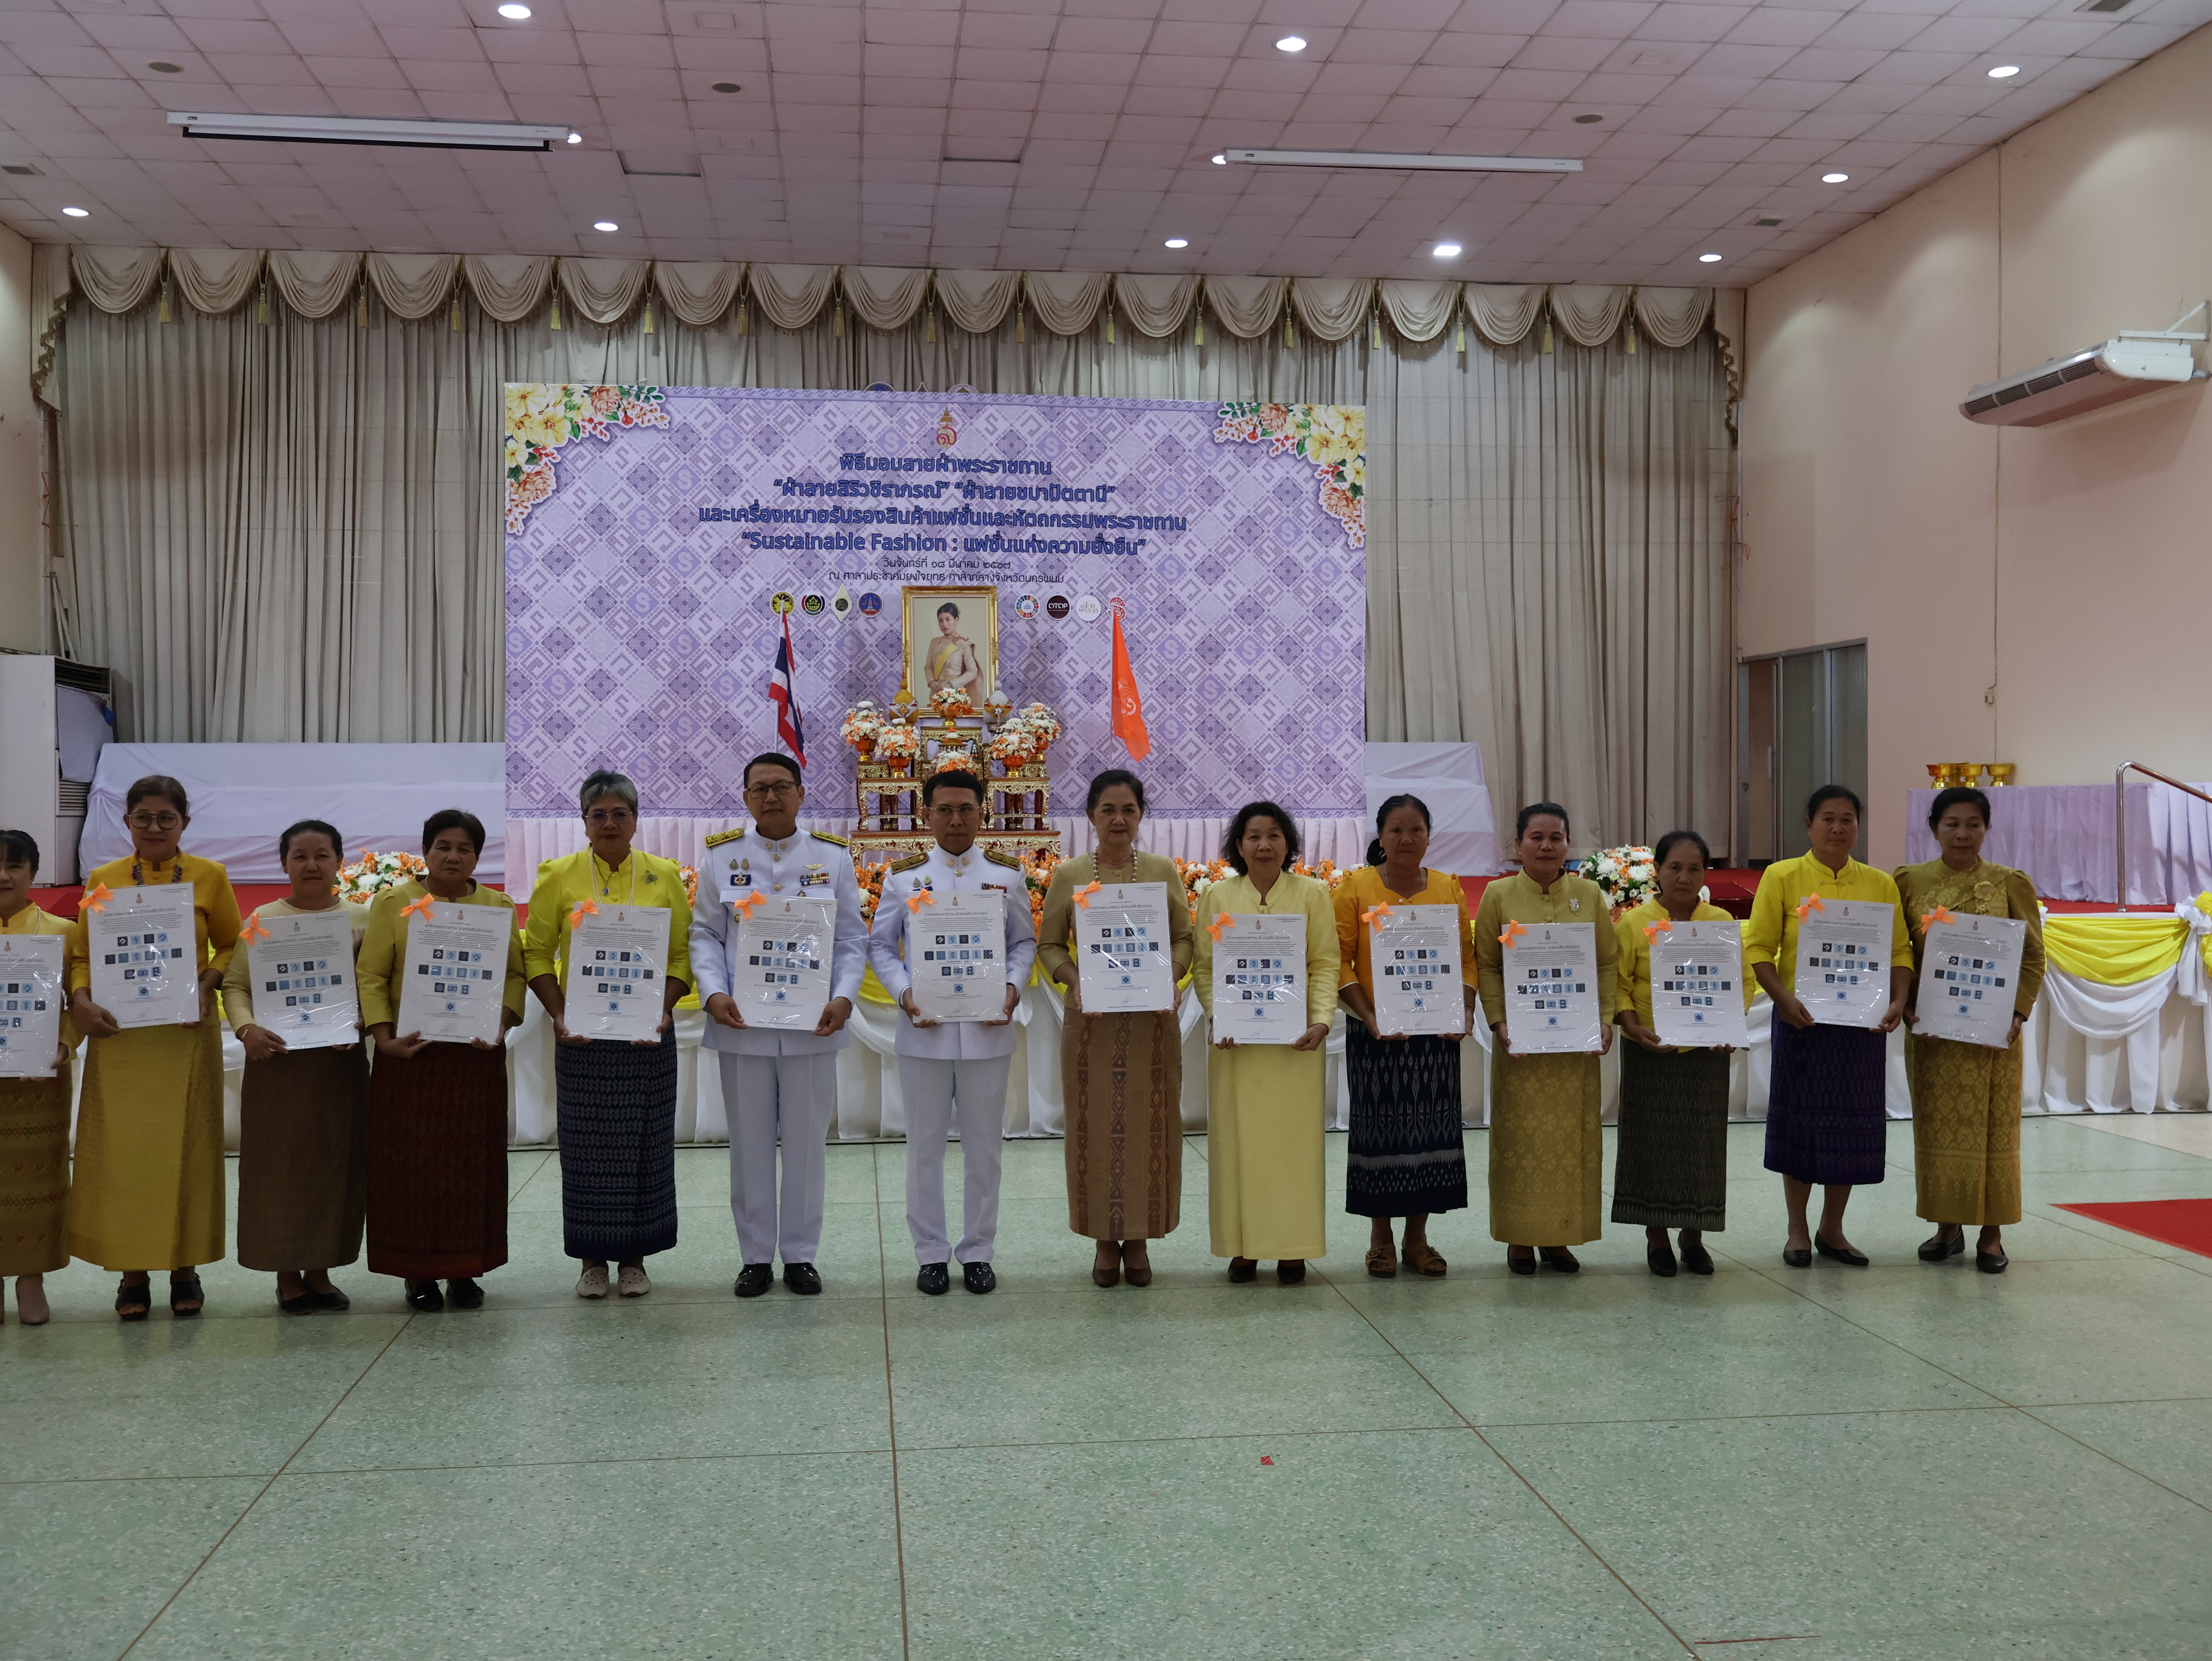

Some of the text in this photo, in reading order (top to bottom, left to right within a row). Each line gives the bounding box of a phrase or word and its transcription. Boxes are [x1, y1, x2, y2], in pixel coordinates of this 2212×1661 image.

[839, 453, 1052, 475] พิธีมอบลายผ้าพระราชทาน
[773, 477, 1116, 502] “ผ้าลายสิริวชิราภรณ์” “ผ้าลายชบาปัตตานี”
[699, 500, 1187, 530] และเครื่องหมายรับรองสินค้าแฟชั่นและหัตถกรรมพระราชทาน
[741, 531, 1146, 555] “Sustainable Fashion : แฟชั่นแห่งความยั่งยืน”
[883, 556, 928, 568] วันจันทร์ที่
[949, 558, 979, 568] มีนาคม
[829, 571, 839, 580] ณ
[949, 572, 1064, 583] ศาลากลางจังหวัดนครพนม
